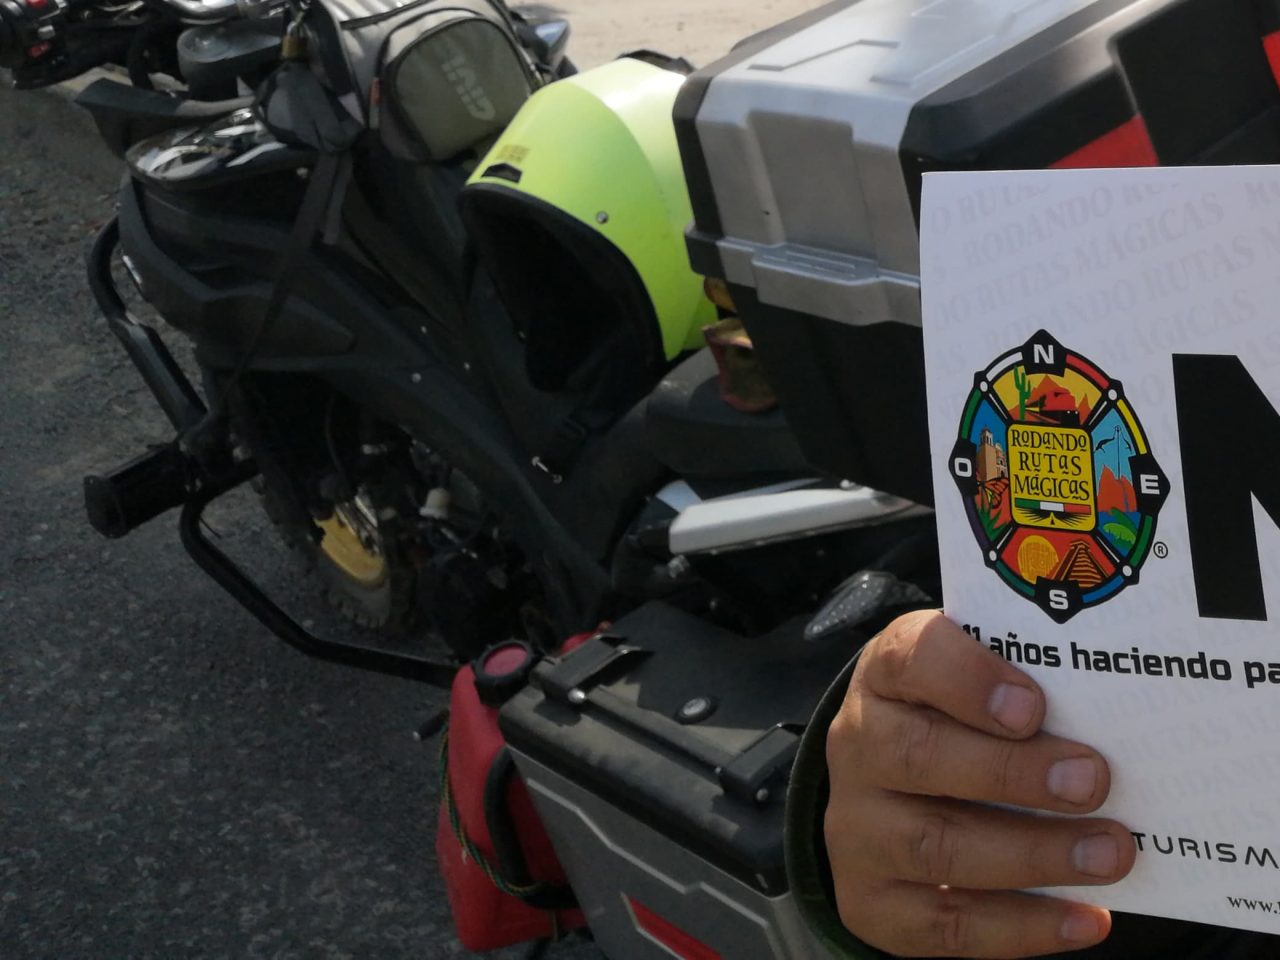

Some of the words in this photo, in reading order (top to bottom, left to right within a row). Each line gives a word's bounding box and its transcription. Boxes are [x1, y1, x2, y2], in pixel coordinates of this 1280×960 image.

[1033, 344, 1054, 365] N
[1140, 474, 1160, 495] E
[1049, 589, 1069, 611] S
[990, 632, 1061, 668] años
[1070, 642, 1232, 681] haciendo
